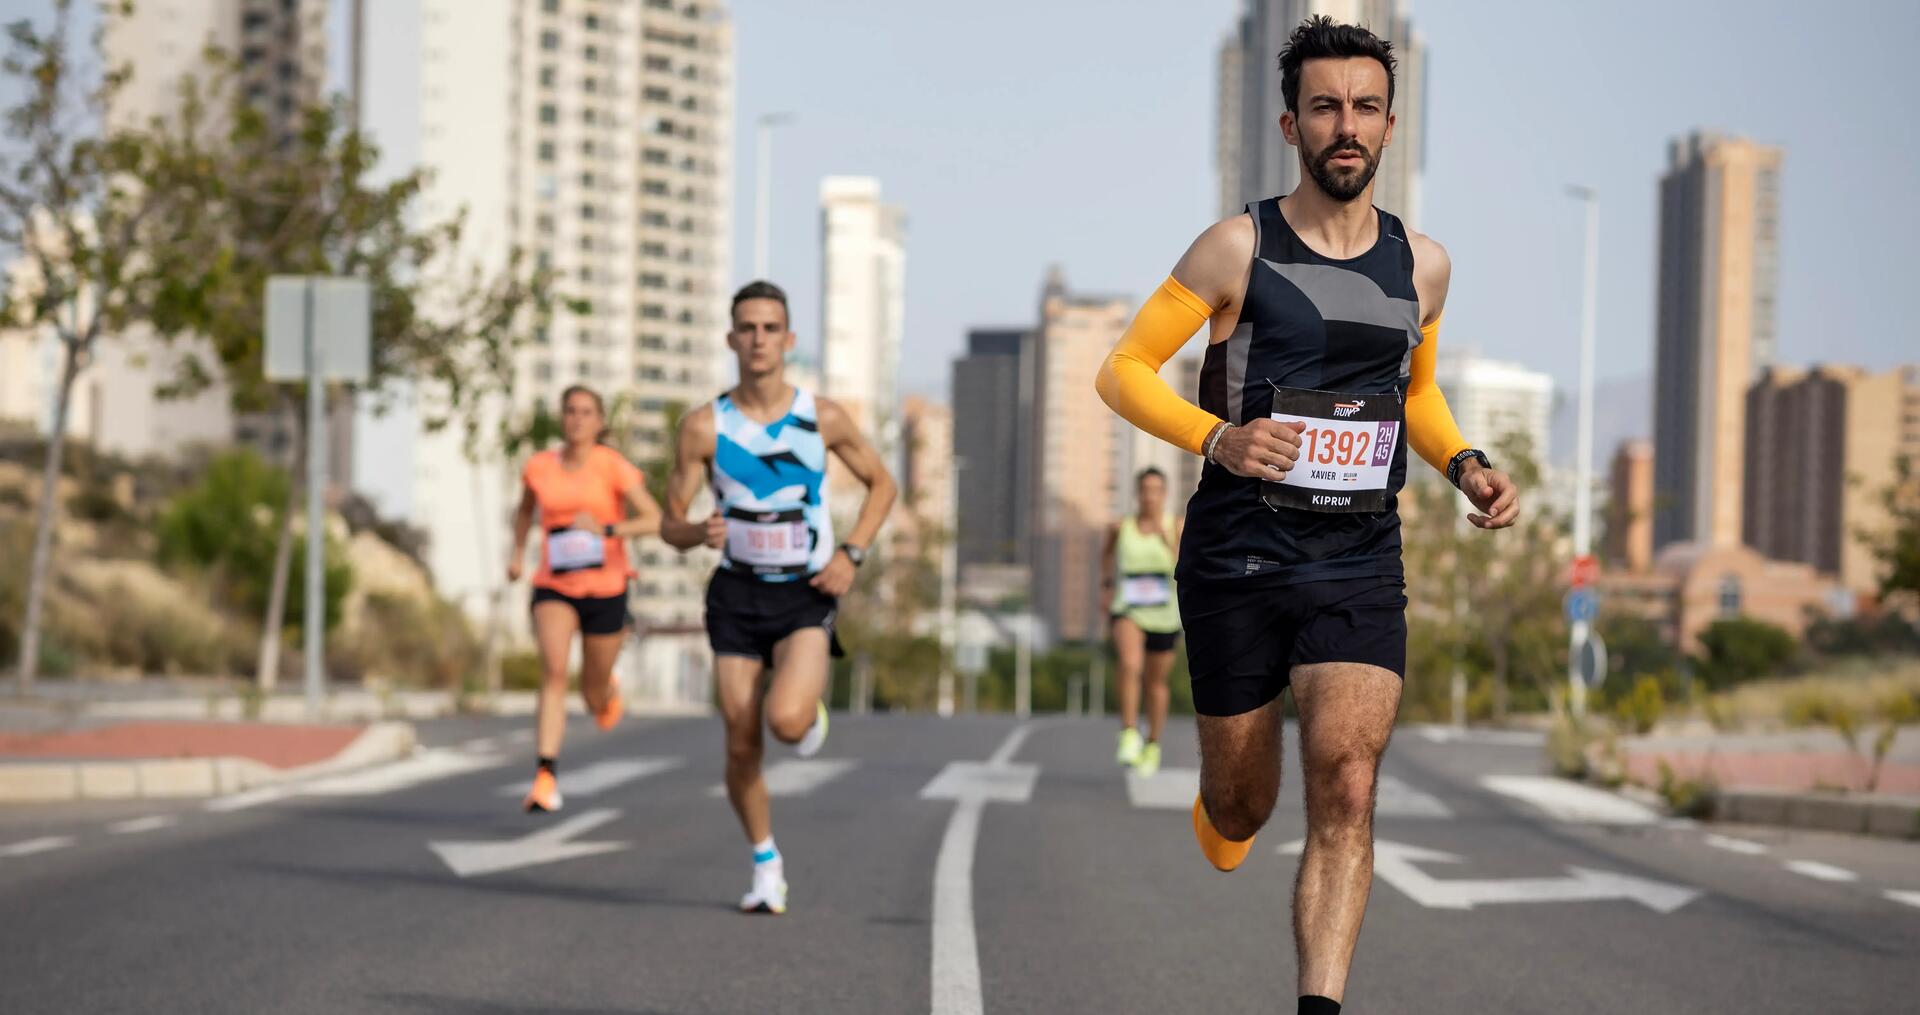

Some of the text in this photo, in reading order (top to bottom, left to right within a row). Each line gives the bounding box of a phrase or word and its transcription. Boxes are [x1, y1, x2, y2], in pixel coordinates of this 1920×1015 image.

[1333, 407, 1351, 417] RUN
[1377, 427, 1393, 443] 2H
[1306, 428, 1370, 465] 1392
[1375, 444, 1389, 460] 45
[1310, 470, 1337, 480] XAVIER
[1312, 495, 1352, 506] KIPRUN
